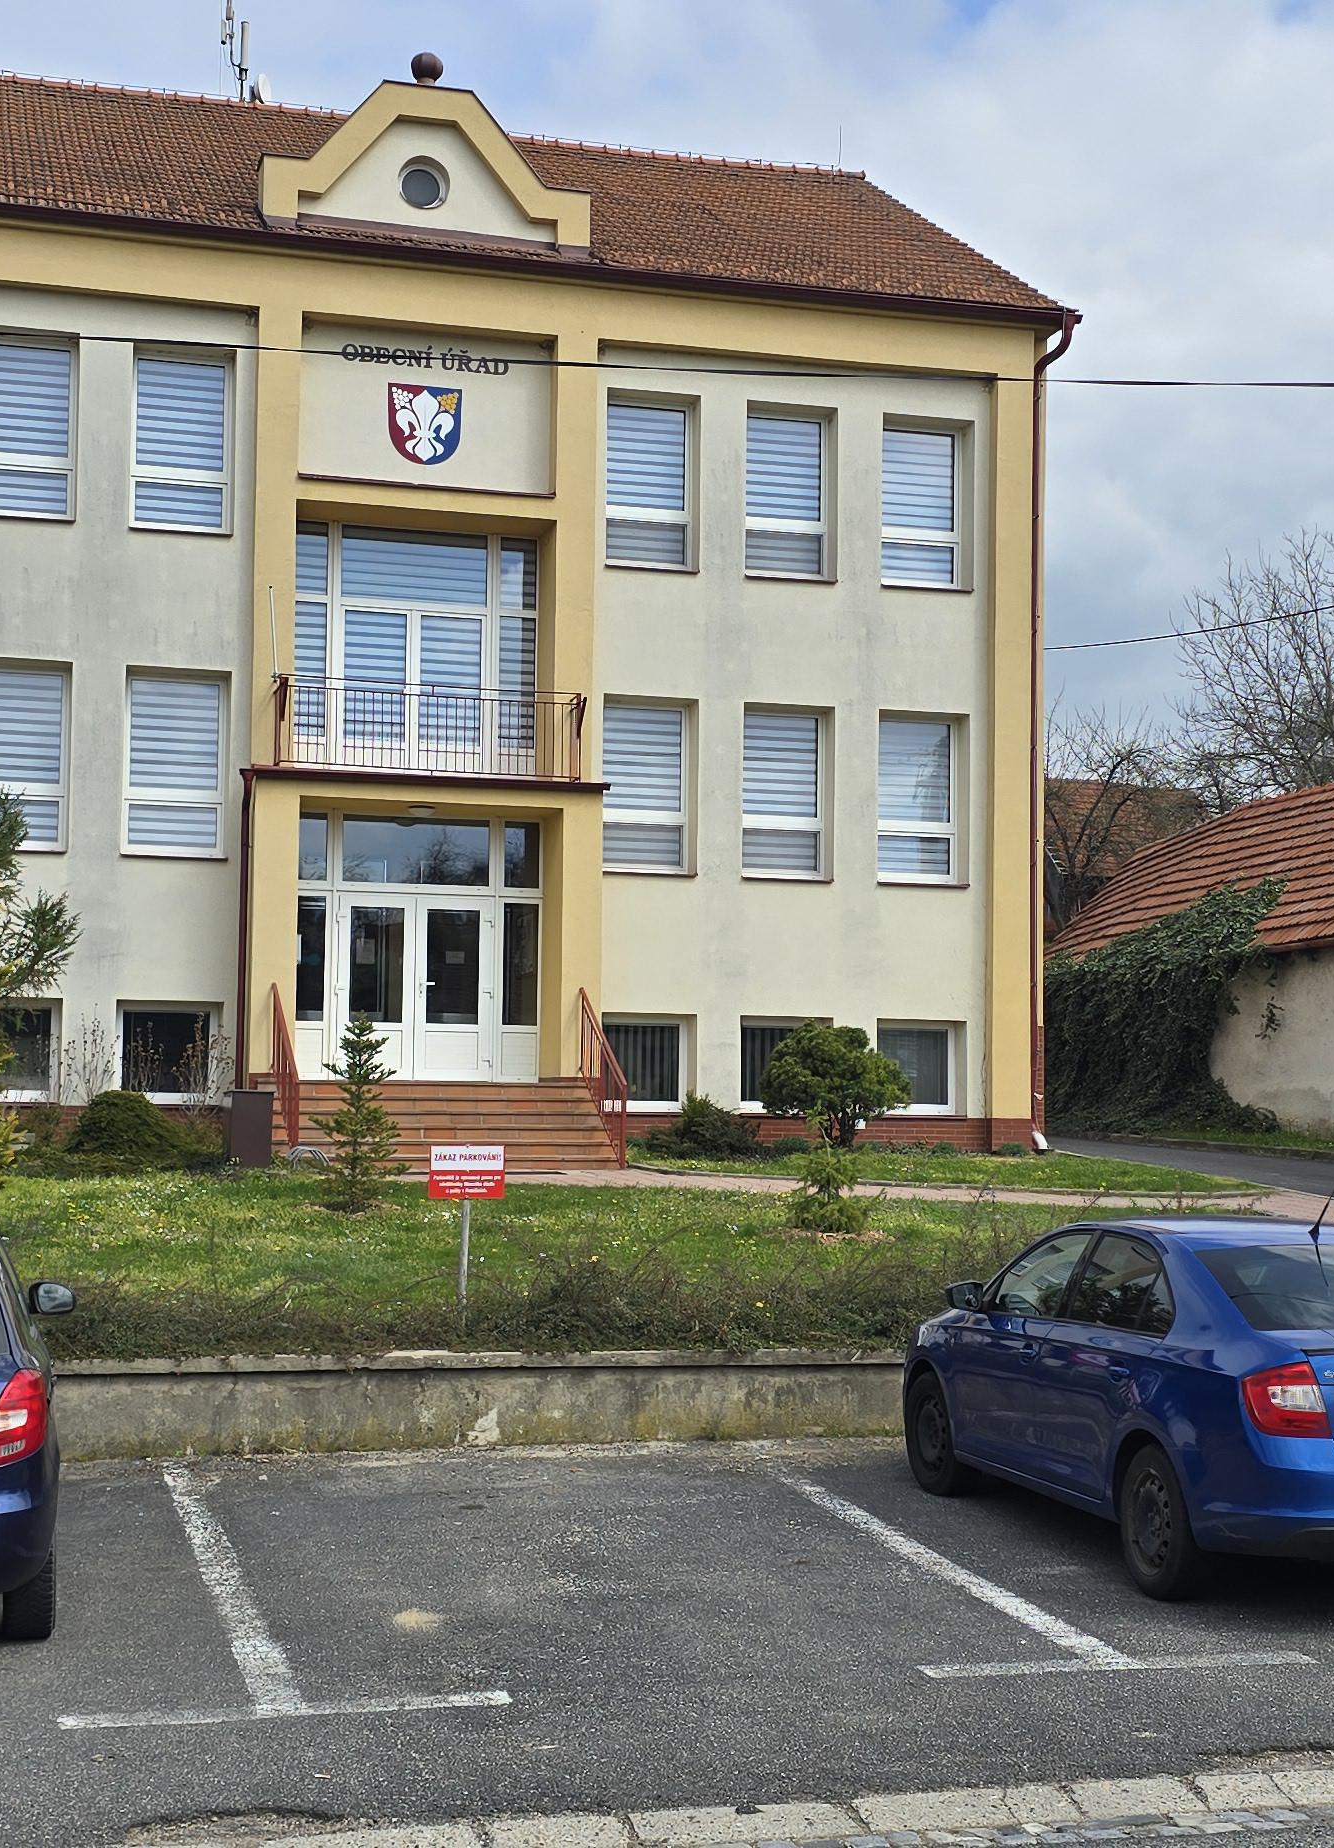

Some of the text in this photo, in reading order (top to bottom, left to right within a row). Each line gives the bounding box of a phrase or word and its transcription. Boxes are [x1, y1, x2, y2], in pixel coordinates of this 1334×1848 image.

[341, 343, 510, 376] OBECNÍ ÚŘAD
[435, 1152, 456, 1161] ZÁKAZ
